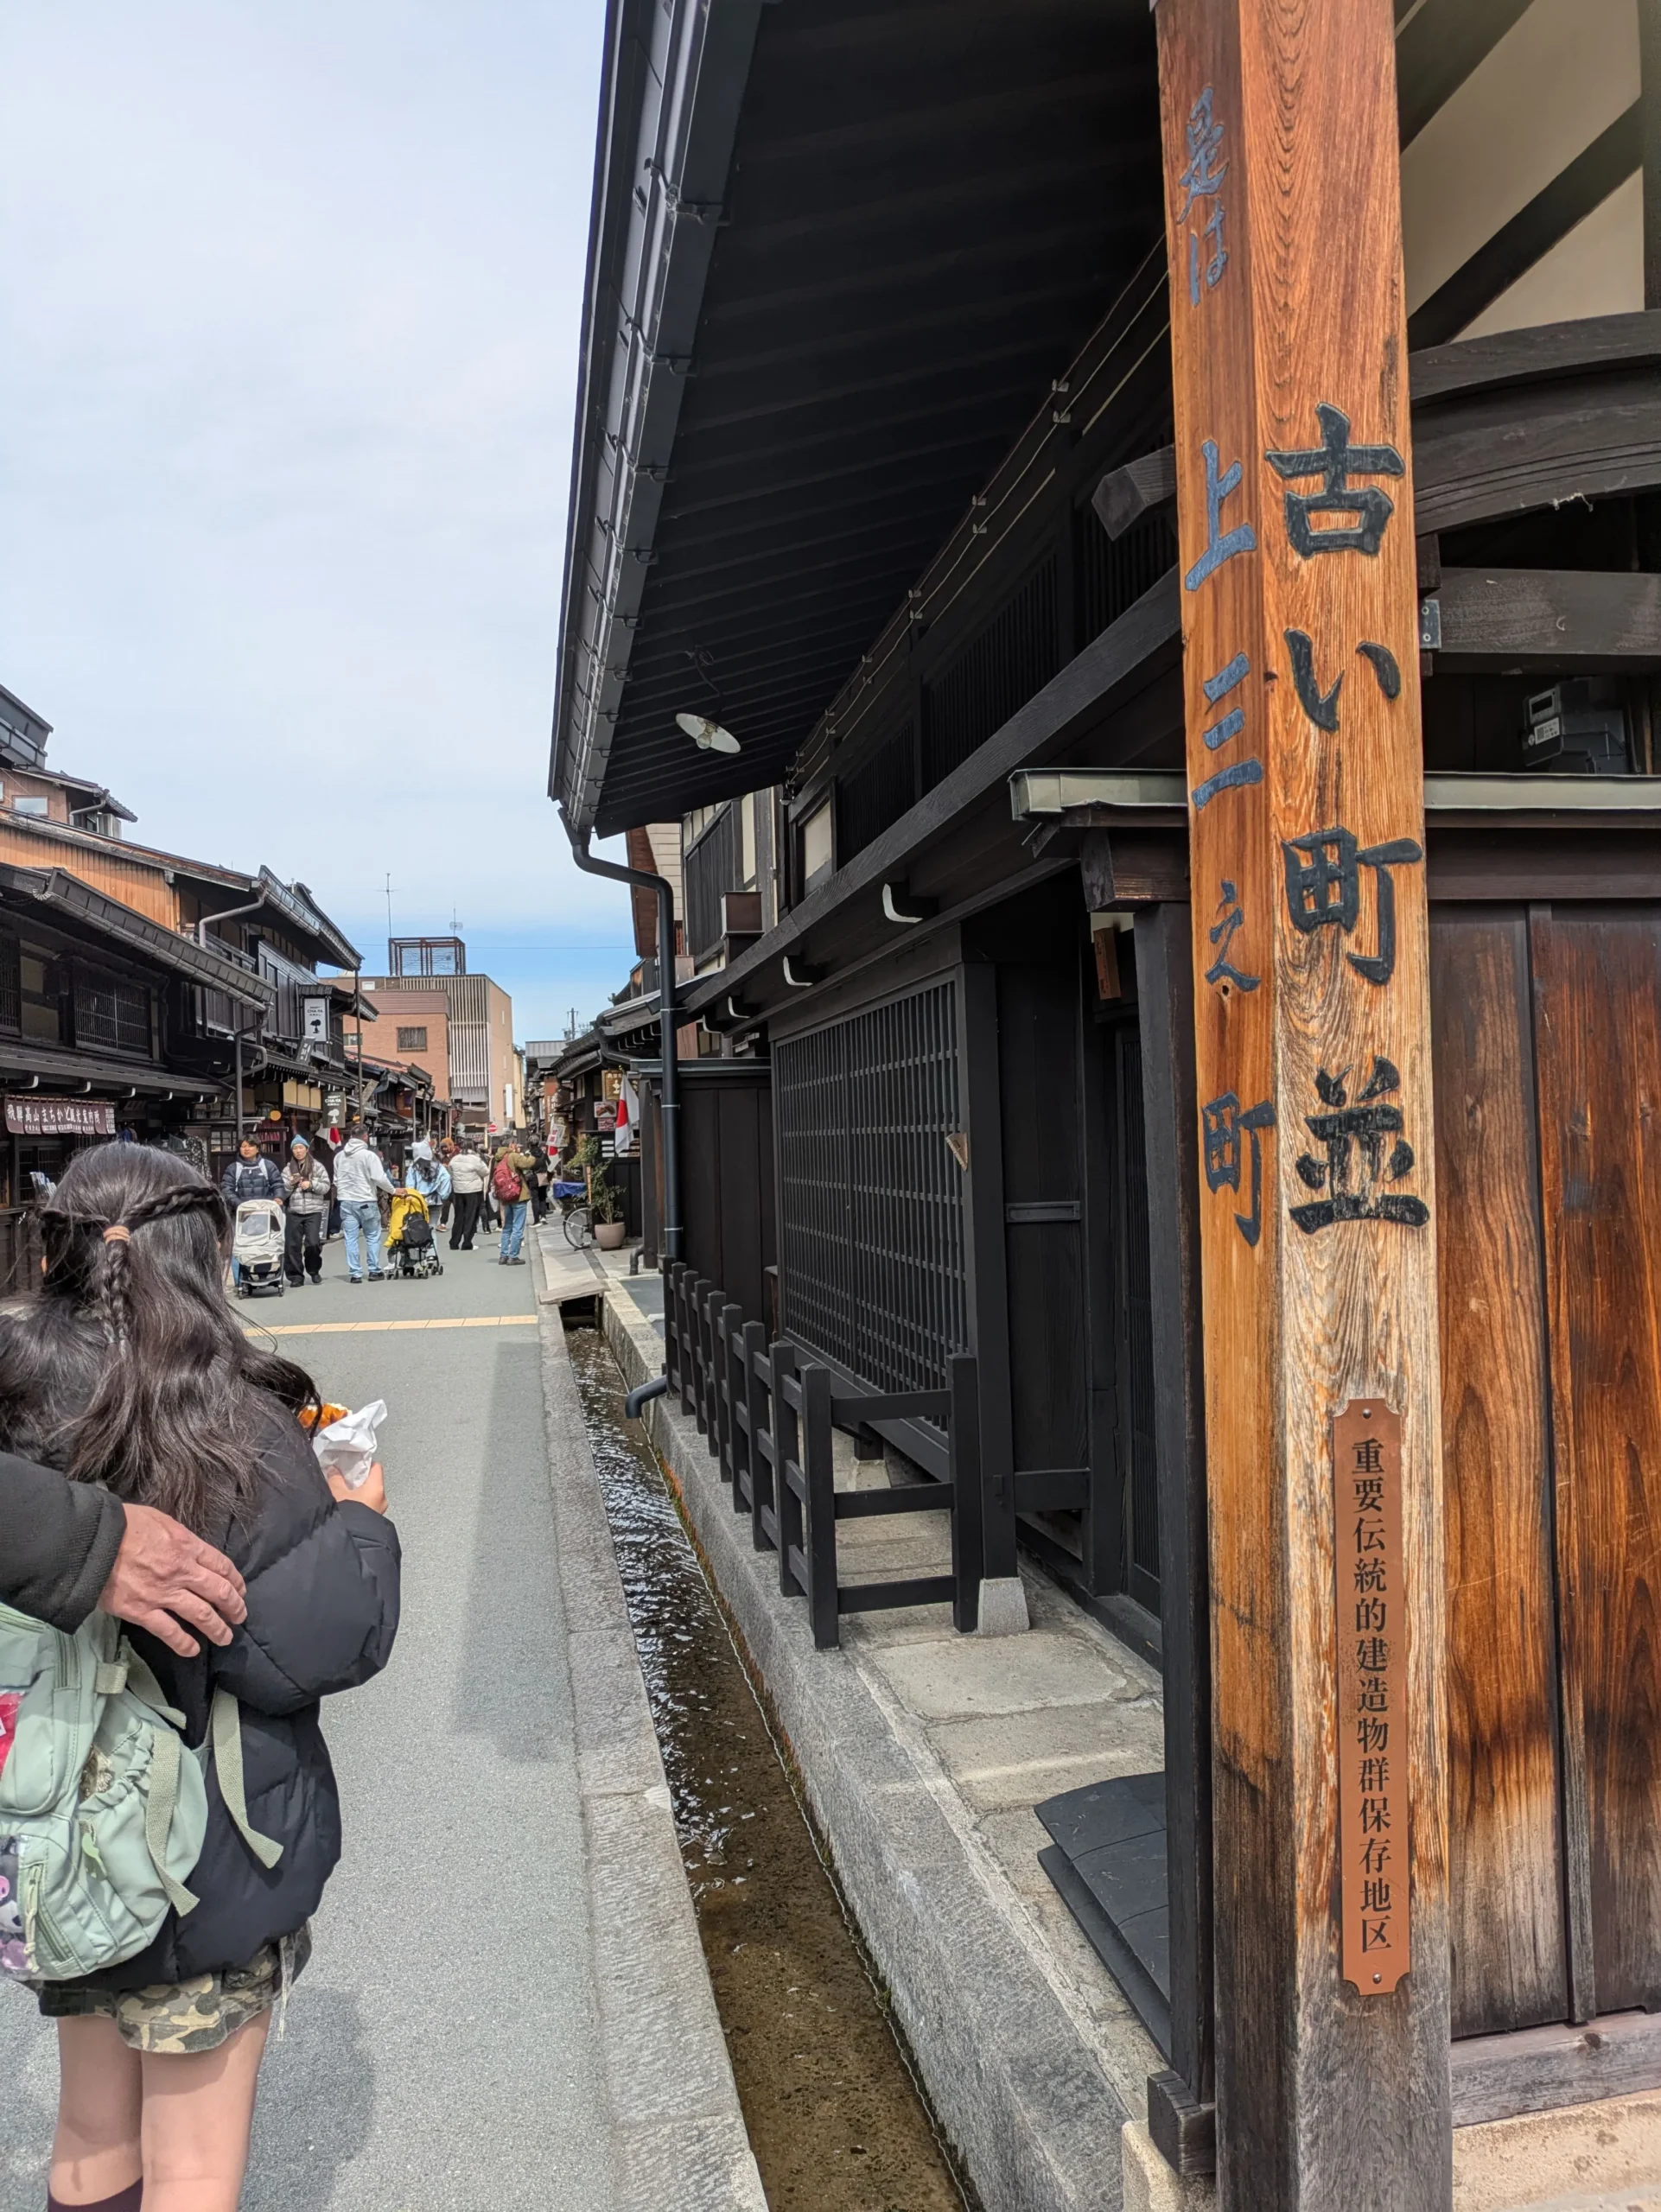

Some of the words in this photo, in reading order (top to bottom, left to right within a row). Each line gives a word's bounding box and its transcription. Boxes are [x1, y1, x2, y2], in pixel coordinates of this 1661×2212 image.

[1265, 401, 1430, 1234] 古い町並
[1351, 1438, 1392, 1954] 重要伝統的建造物群保存地区
